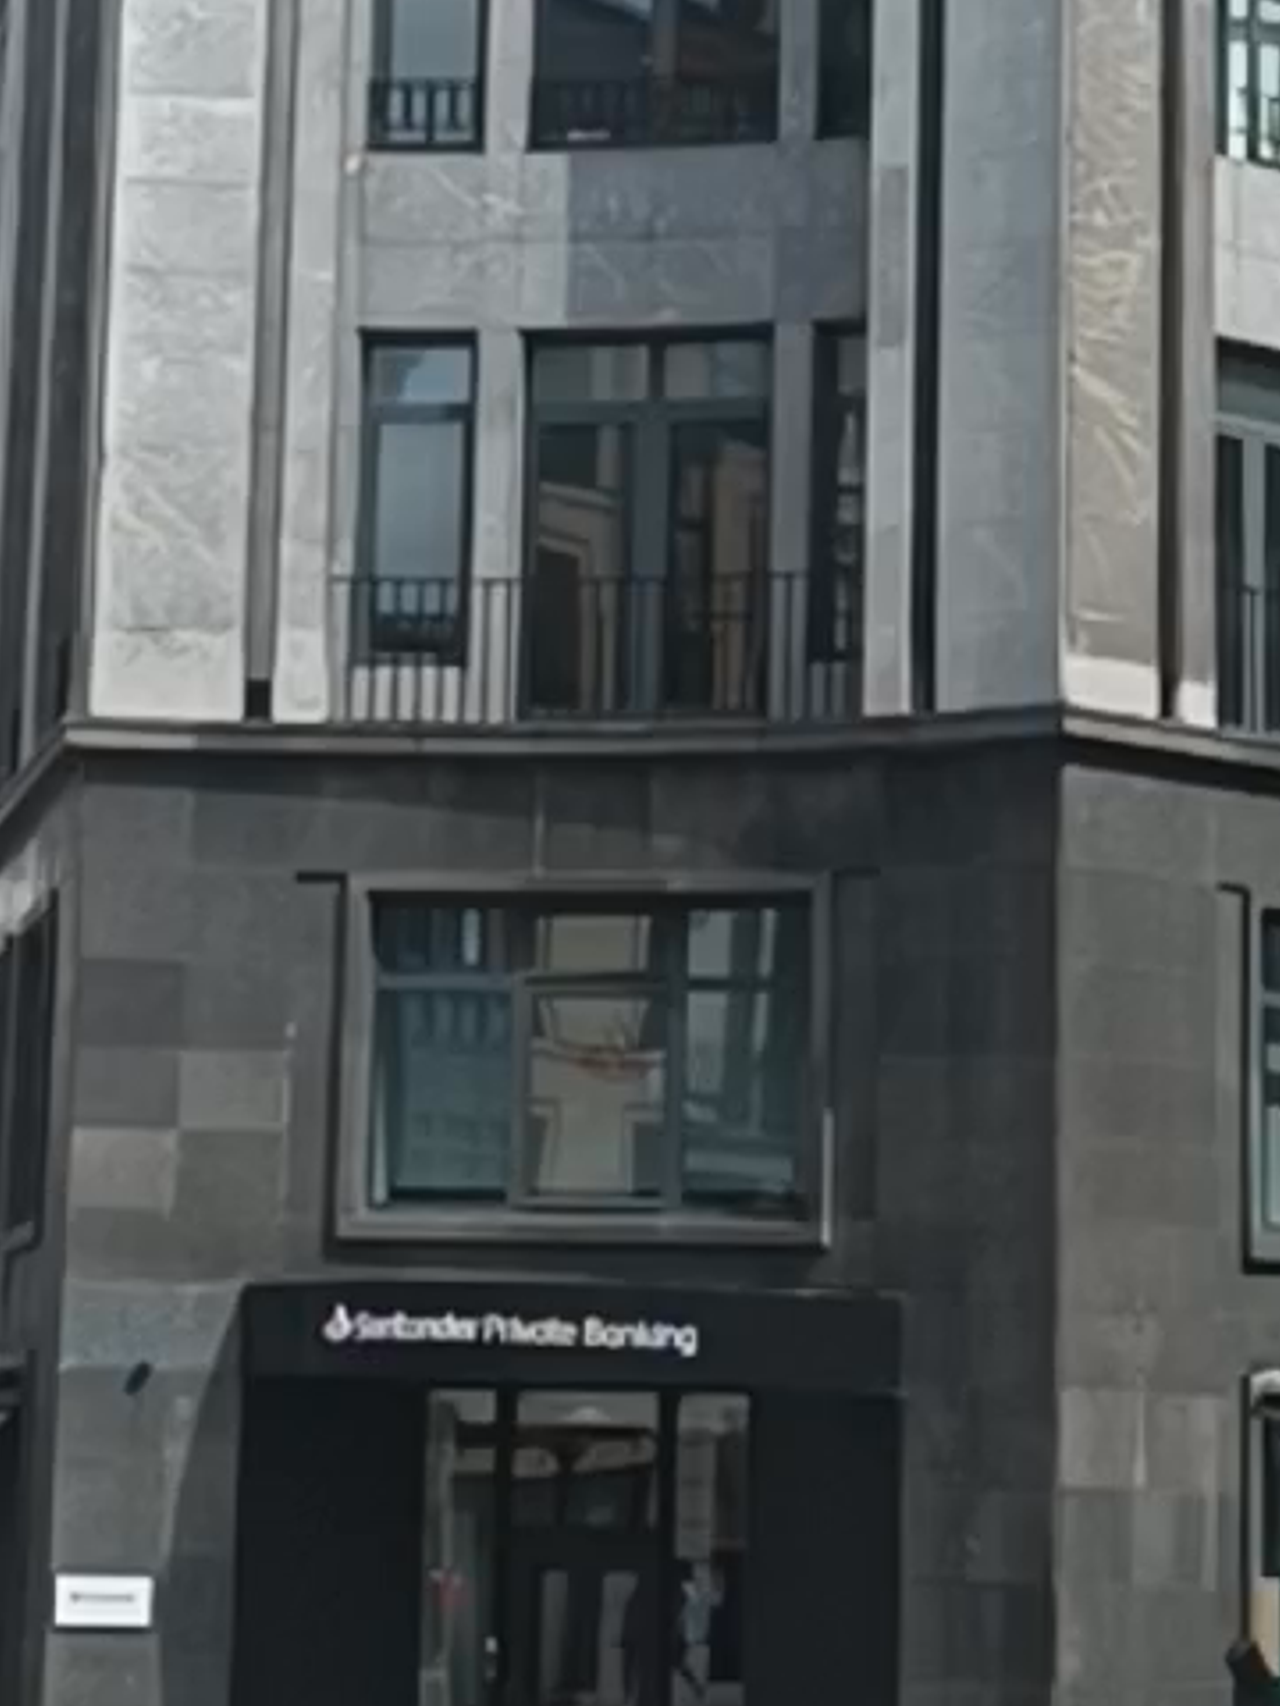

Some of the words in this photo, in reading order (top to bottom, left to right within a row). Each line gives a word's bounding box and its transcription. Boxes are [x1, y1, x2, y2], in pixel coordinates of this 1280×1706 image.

[355, 1311, 476, 1342] Santander
[482, 1313, 578, 1347] Private
[584, 1316, 698, 1357] Banking
